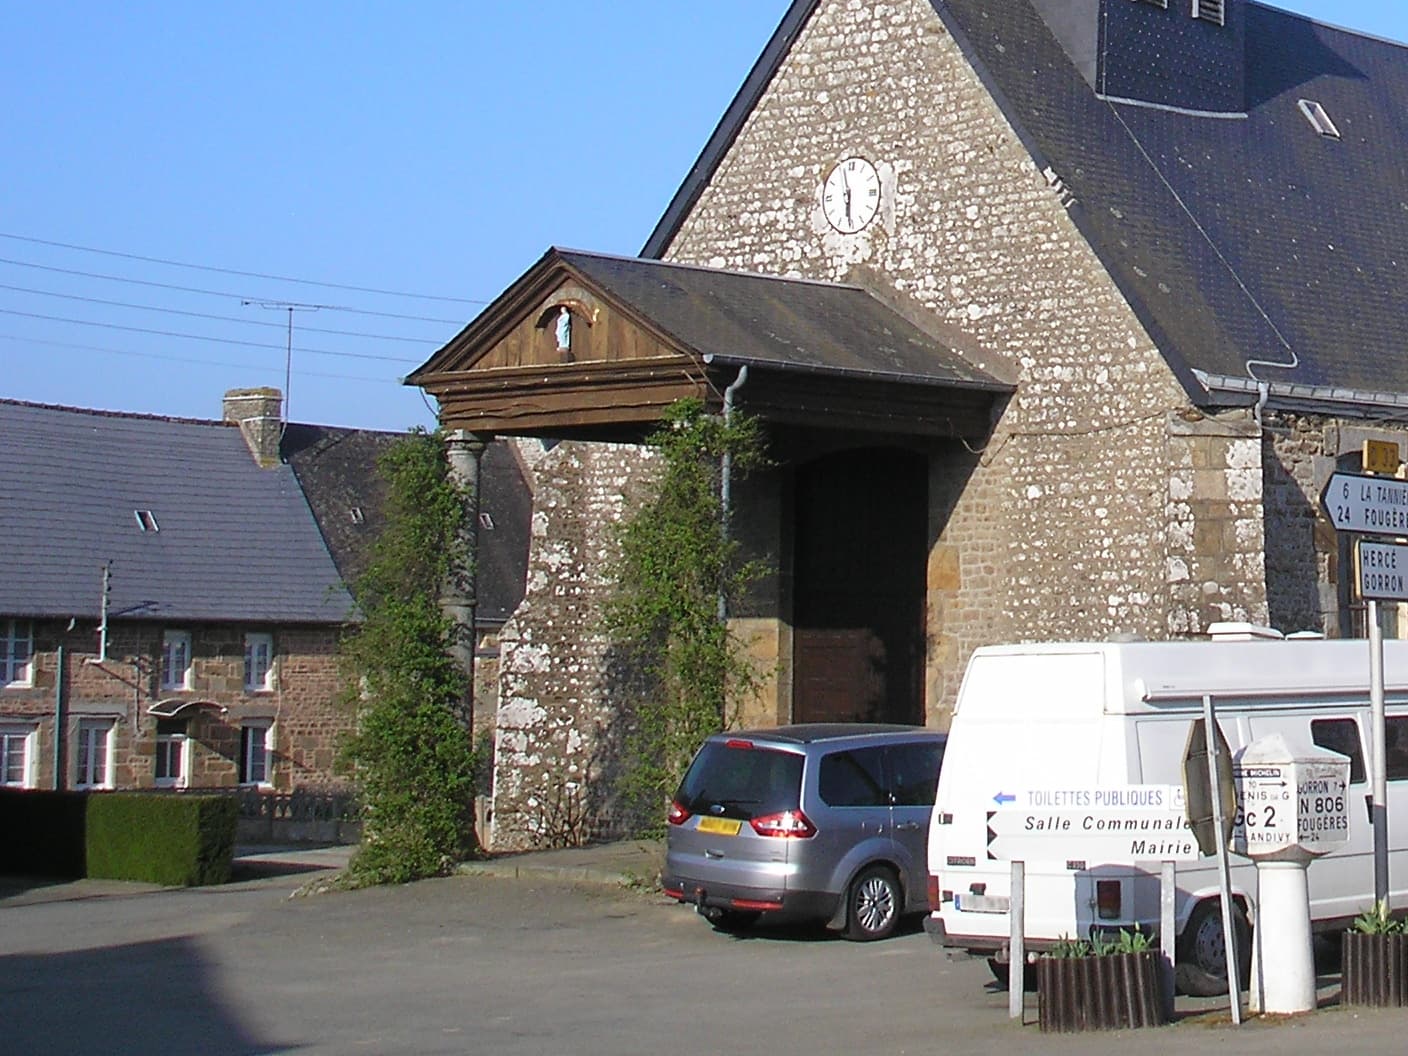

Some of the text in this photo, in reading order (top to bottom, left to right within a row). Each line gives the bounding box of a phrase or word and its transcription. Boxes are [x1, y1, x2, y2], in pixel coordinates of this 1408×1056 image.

[1342, 482, 1350, 500] 6
[1360, 484, 1371, 502] LA
[1337, 505, 1351, 523] 24
[1363, 548, 1396, 569] HERCÉ
[1364, 573, 1403, 592] GORRON
[1250, 769, 1280, 777] MICHELIN
[1027, 790, 1163, 806] TOILETTES PUBLIQUES
[1235, 791, 1268, 801] ENIS
[1282, 792, 1290, 801] G
[1300, 797, 1344, 814] N 806
[1025, 816, 1191, 831] Salle Communale
[1264, 806, 1276, 828] 2
[1311, 833, 1320, 842] 24
[1131, 840, 1192, 855] Mairie
